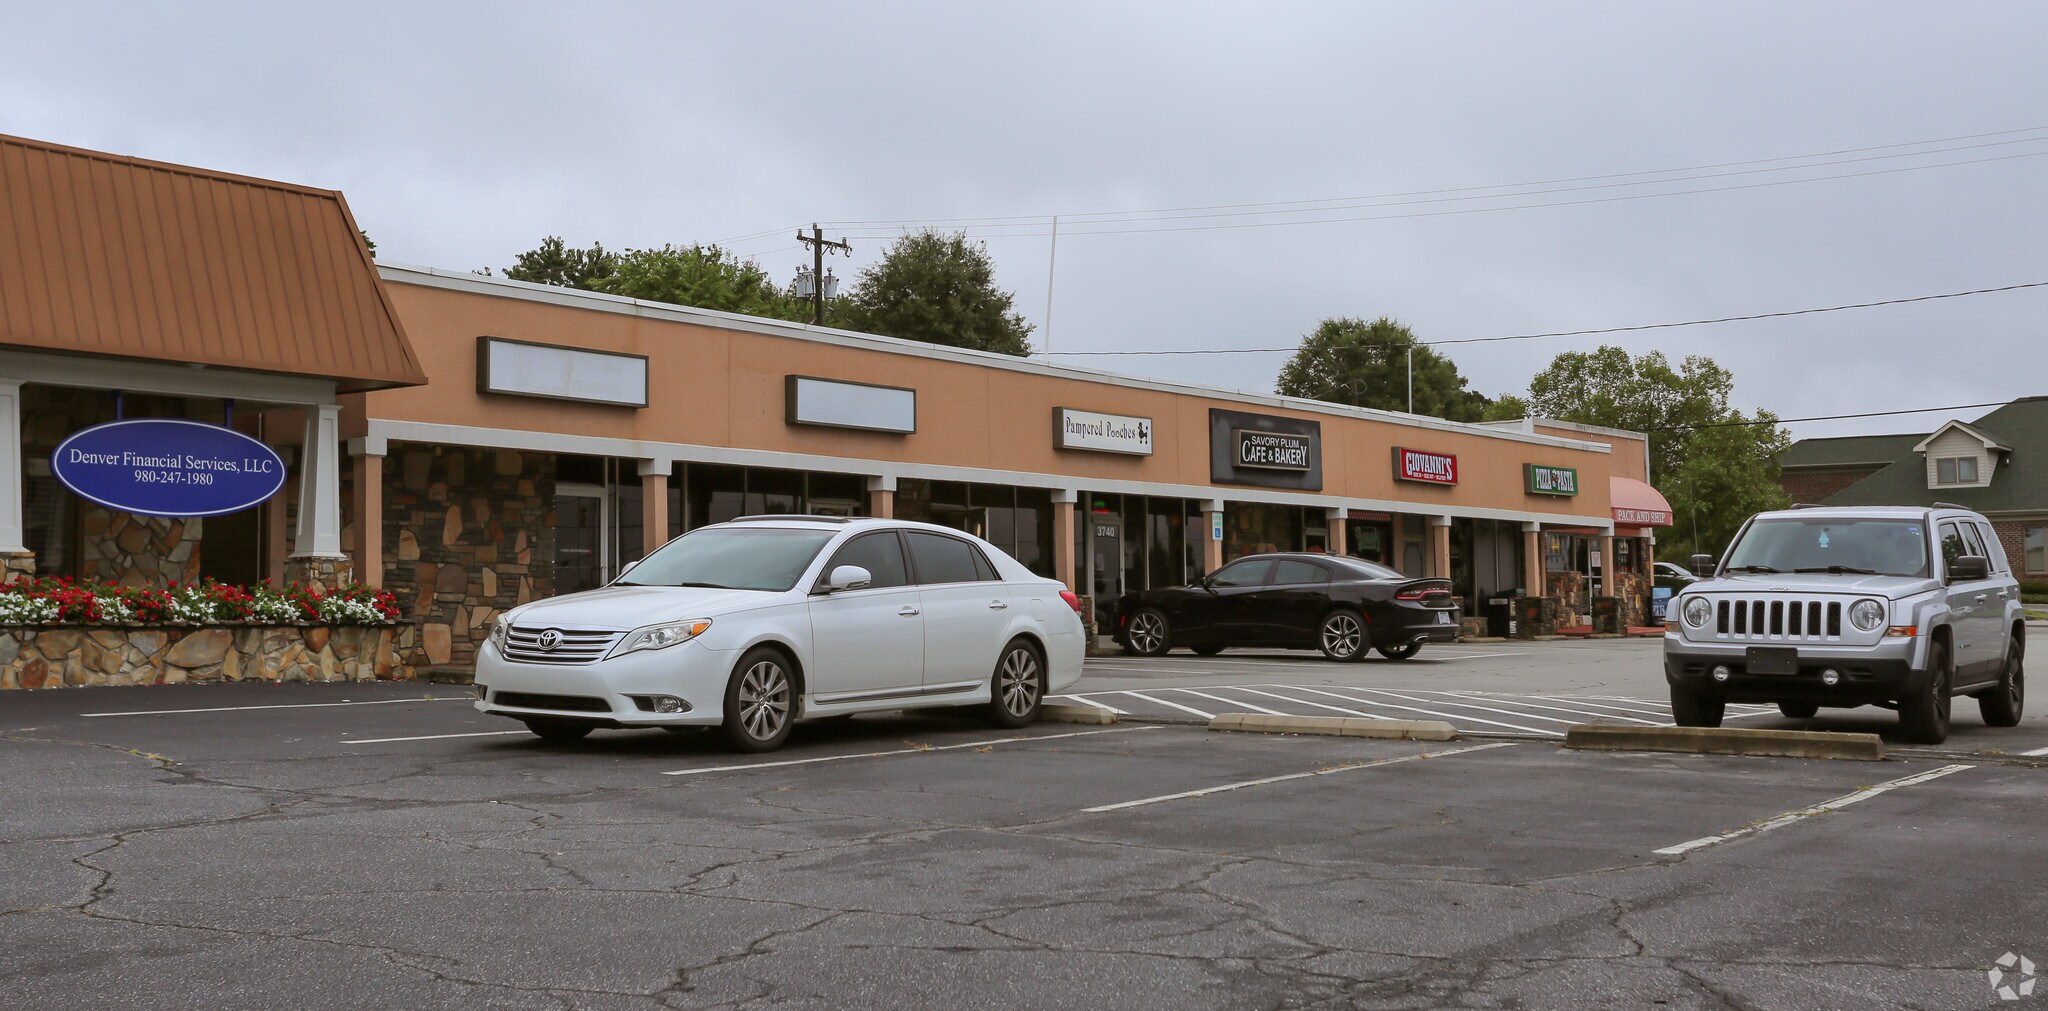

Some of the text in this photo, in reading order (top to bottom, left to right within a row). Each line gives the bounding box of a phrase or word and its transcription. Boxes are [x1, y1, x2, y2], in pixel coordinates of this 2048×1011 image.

[1066, 417, 1136, 441] Pampered Pooches
[1242, 440, 1307, 465] CAFE & BAKERY
[1251, 436, 1299, 448] SAVORY PLUM
[70, 449, 272, 473] Denver Financial Services, LLC
[1406, 452, 1453, 480] GIOVANNI'S
[134, 470, 213, 485] 980-247-1980
[1536, 468, 1574, 491] PIZZA PASTA
[1617, 510, 1665, 523] PACK AND SHIP
[1097, 526, 1115, 537] 3740
